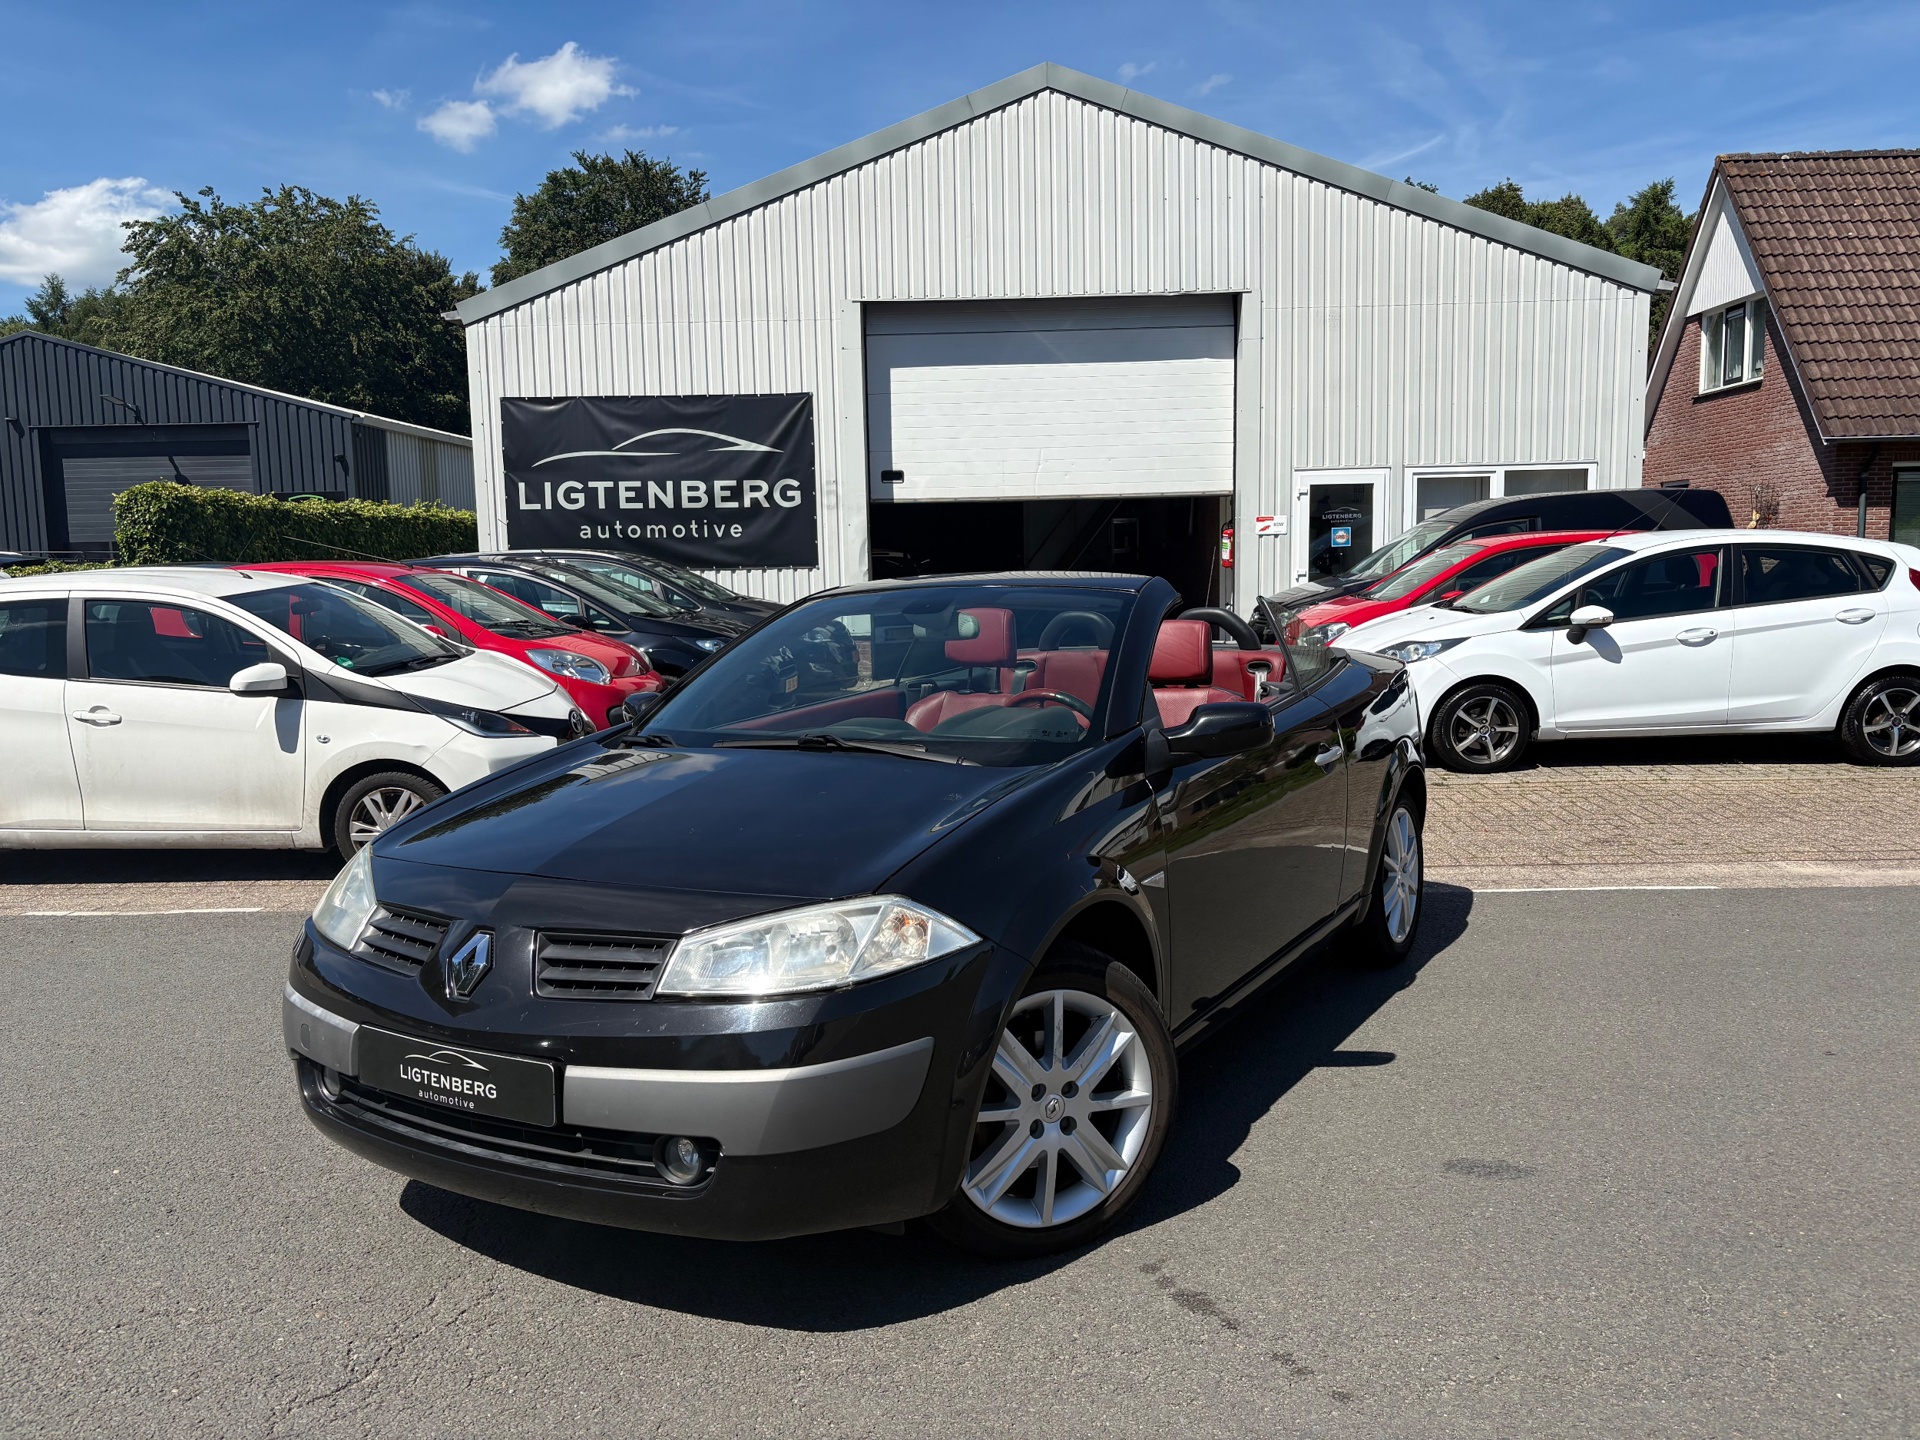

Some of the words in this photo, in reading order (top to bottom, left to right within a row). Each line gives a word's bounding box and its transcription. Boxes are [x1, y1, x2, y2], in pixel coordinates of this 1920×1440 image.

[517, 478, 802, 510] LIGTENBERG
[579, 519, 743, 539] automotive
[400, 1064, 497, 1099] LIGTENBERG
[418, 1088, 475, 1109] automotive
